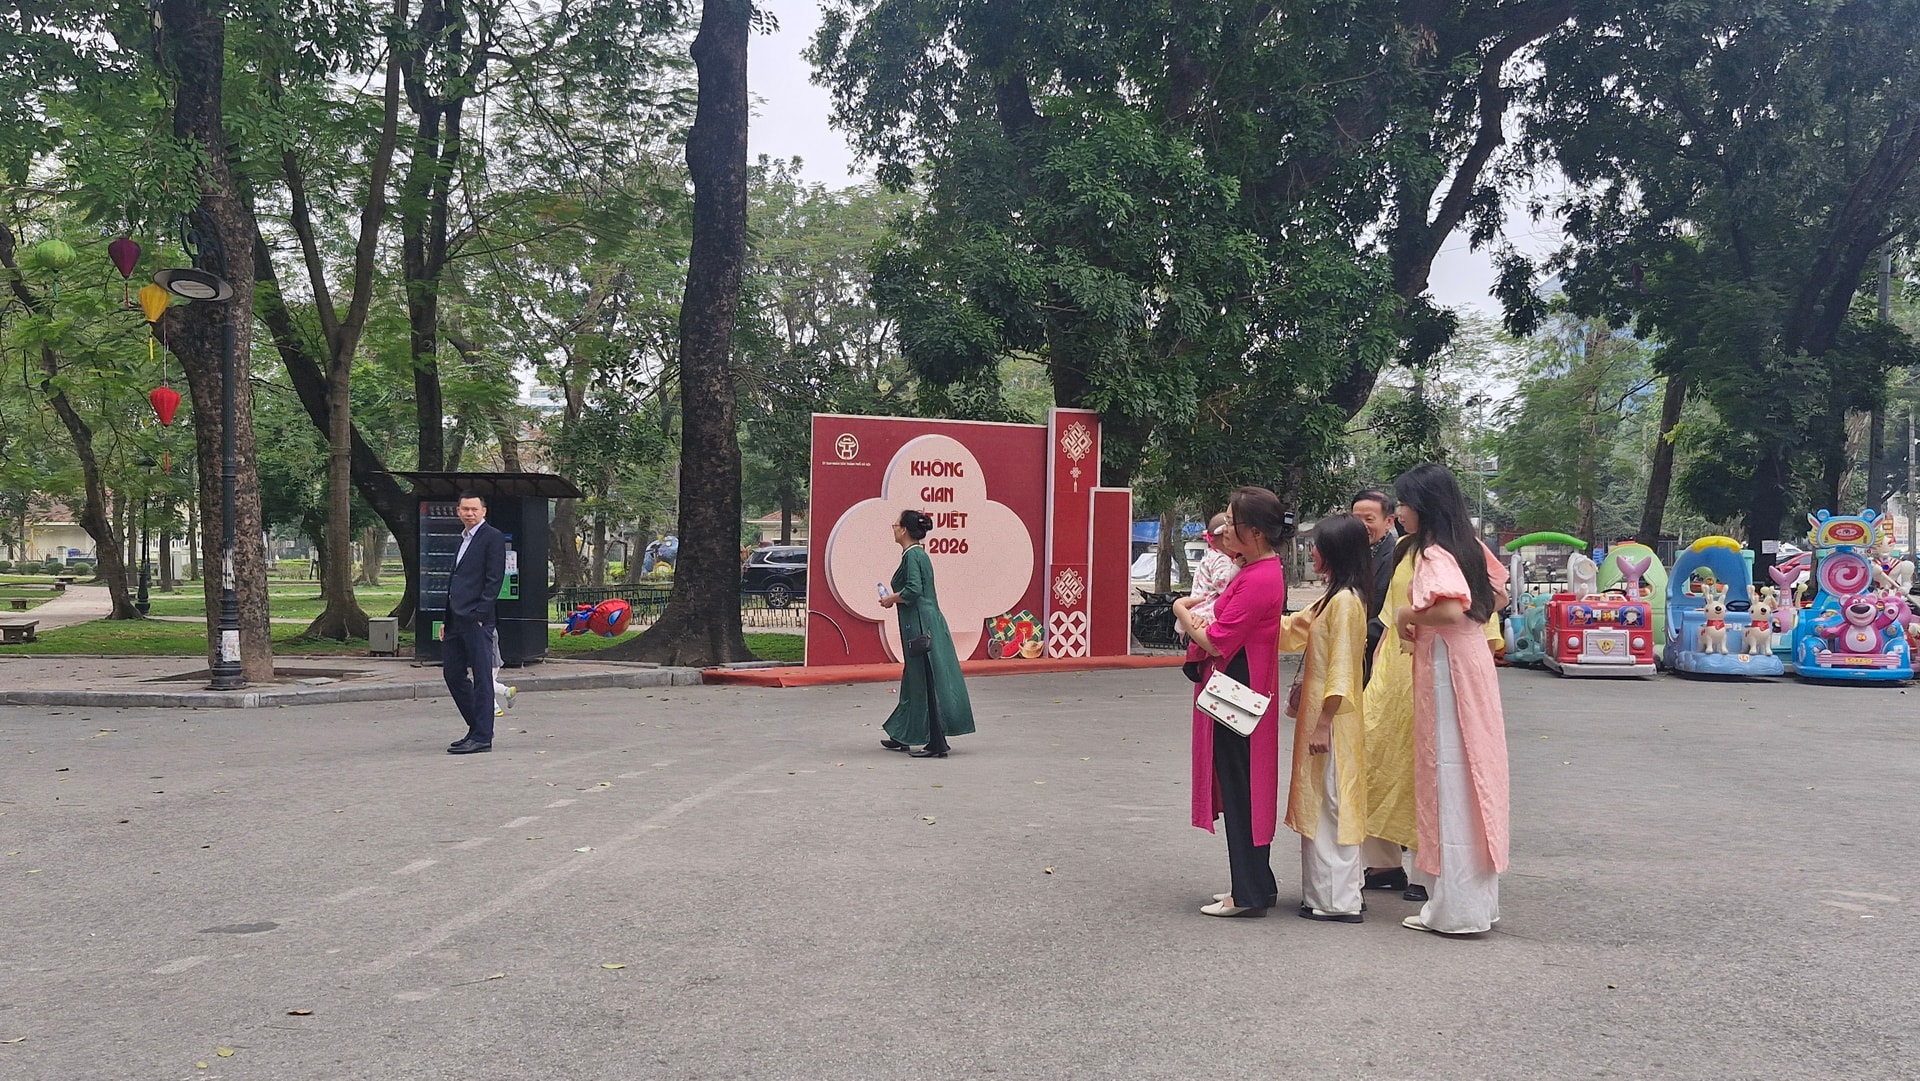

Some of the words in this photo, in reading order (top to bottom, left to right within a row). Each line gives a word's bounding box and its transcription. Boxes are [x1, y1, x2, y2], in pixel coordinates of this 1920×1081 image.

[911, 459, 964, 477] KHÔNG
[921, 487, 954, 503] GIAN
[937, 510, 968, 531] VIỆT
[929, 538, 969, 554] 2026
